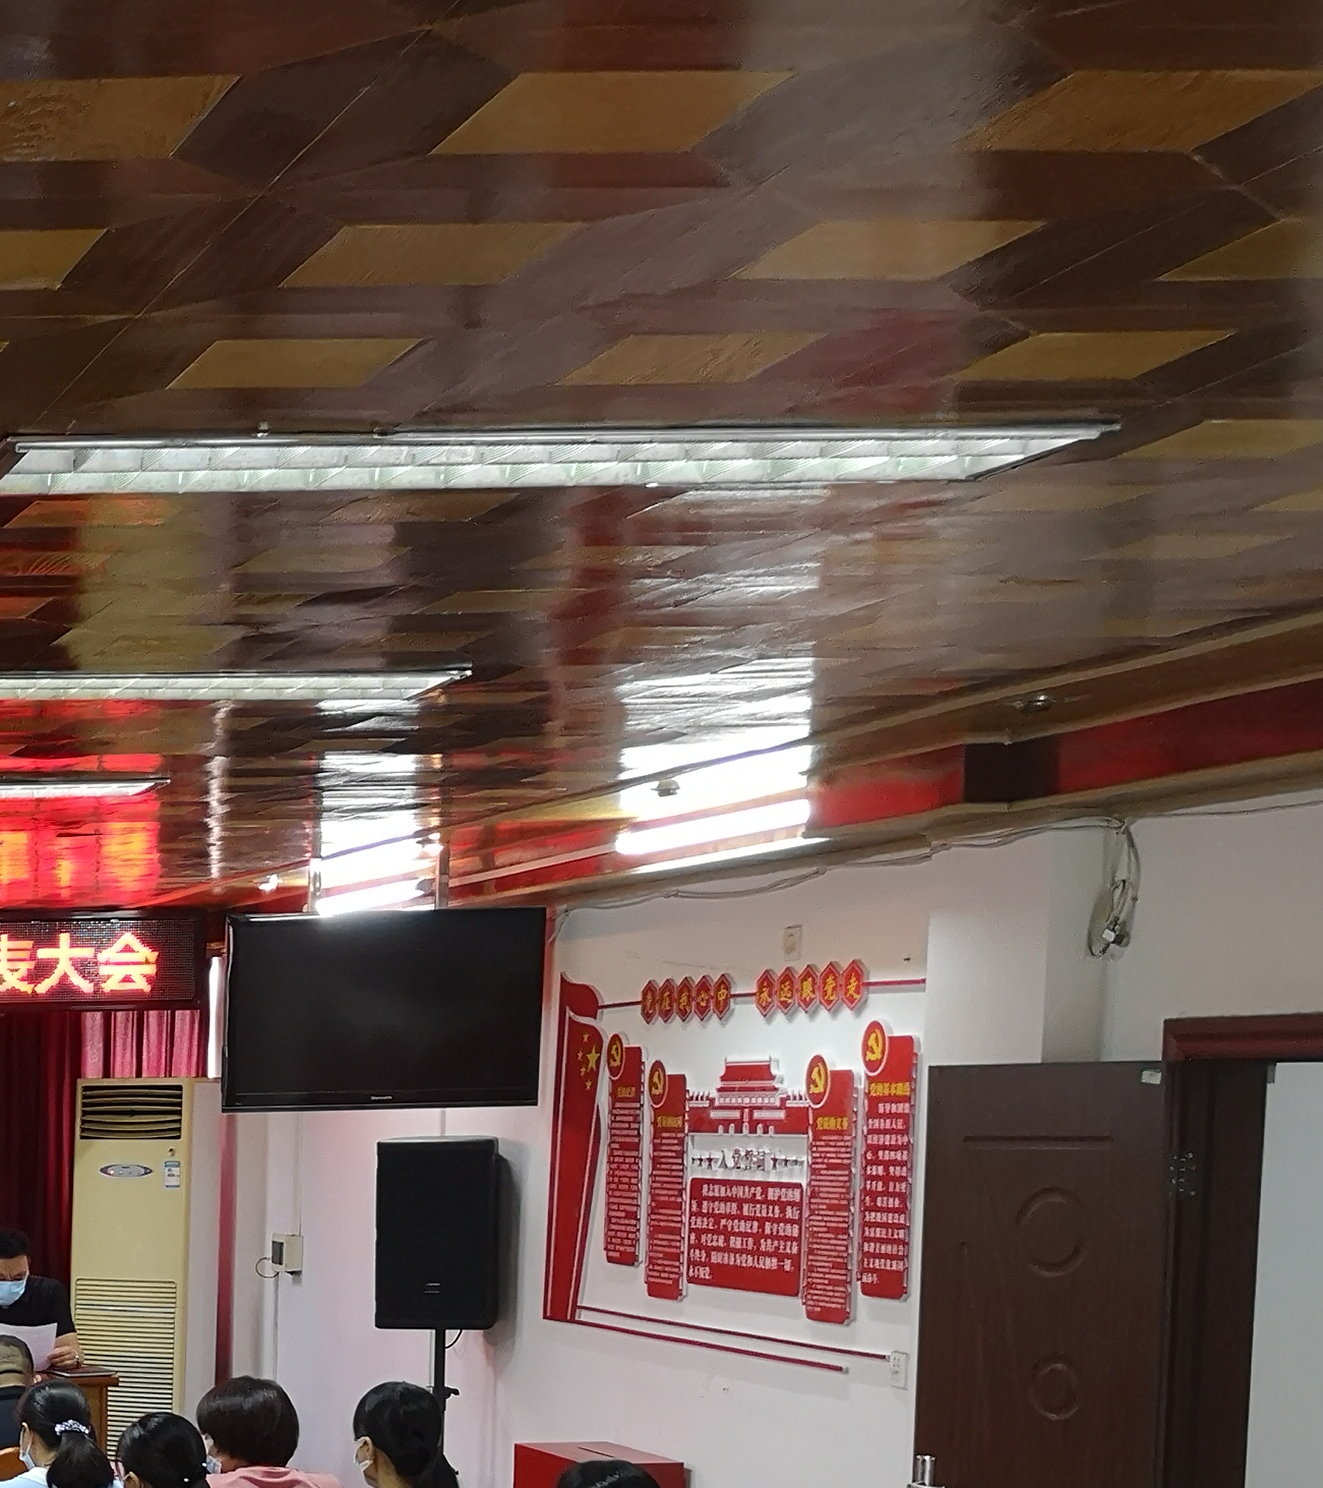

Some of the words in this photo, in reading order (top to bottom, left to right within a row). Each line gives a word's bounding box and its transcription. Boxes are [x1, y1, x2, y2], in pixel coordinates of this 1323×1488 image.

[756, 966, 859, 1007] 永远跟党走
